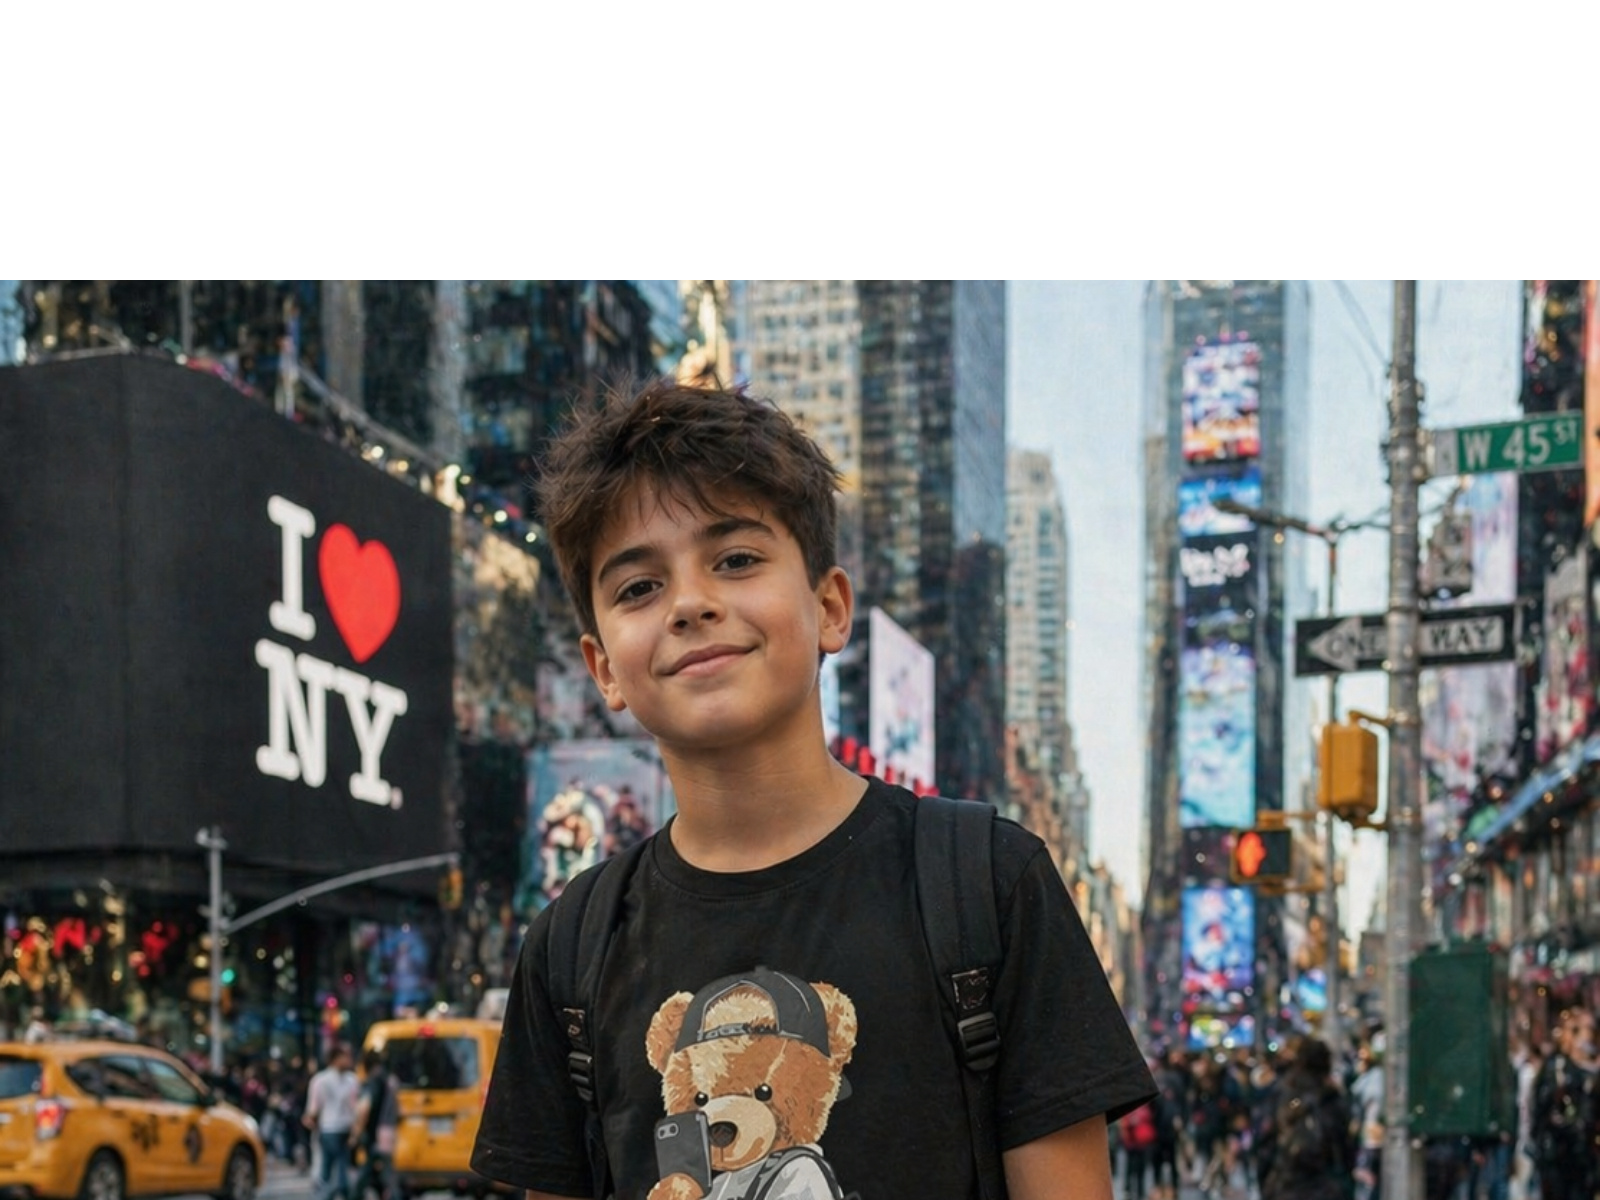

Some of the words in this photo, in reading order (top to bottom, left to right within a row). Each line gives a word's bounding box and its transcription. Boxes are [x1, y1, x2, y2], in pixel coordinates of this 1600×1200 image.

[1462, 430, 1491, 470] W
[1502, 424, 1550, 466] 45
[268, 495, 316, 641] I
[1429, 622, 1495, 652] WAY
